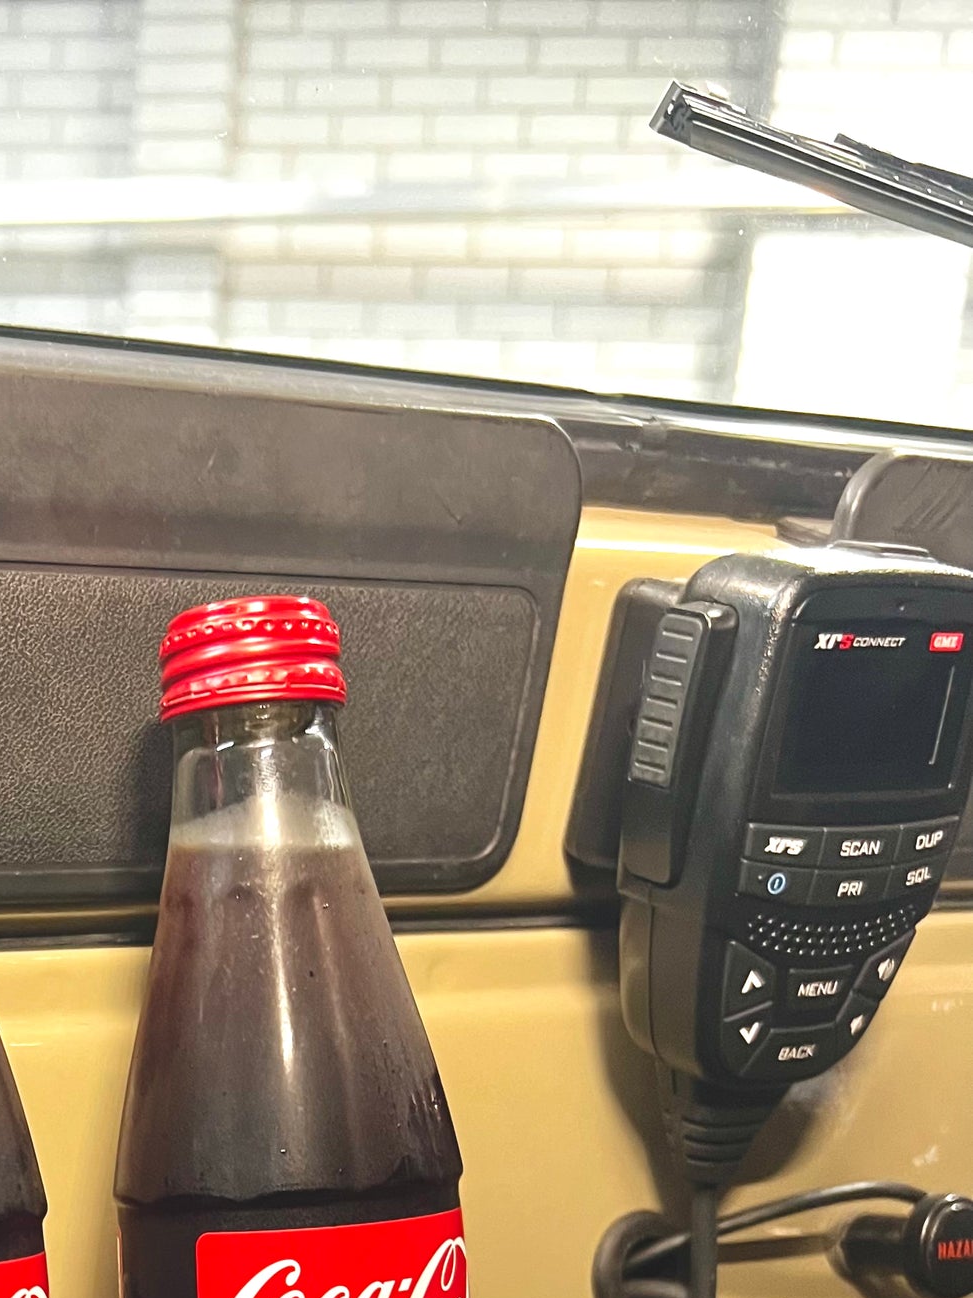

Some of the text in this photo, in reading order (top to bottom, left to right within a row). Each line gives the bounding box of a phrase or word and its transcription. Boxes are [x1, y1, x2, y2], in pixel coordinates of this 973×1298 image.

[853, 636, 907, 648] CONNECT
[839, 839, 881, 857] SCAN
[915, 830, 944, 850] DUP
[905, 866, 932, 886] SQL
[836, 880, 864, 897] PRI
[797, 980, 839, 997] MENU
[778, 1044, 816, 1061] BACK
